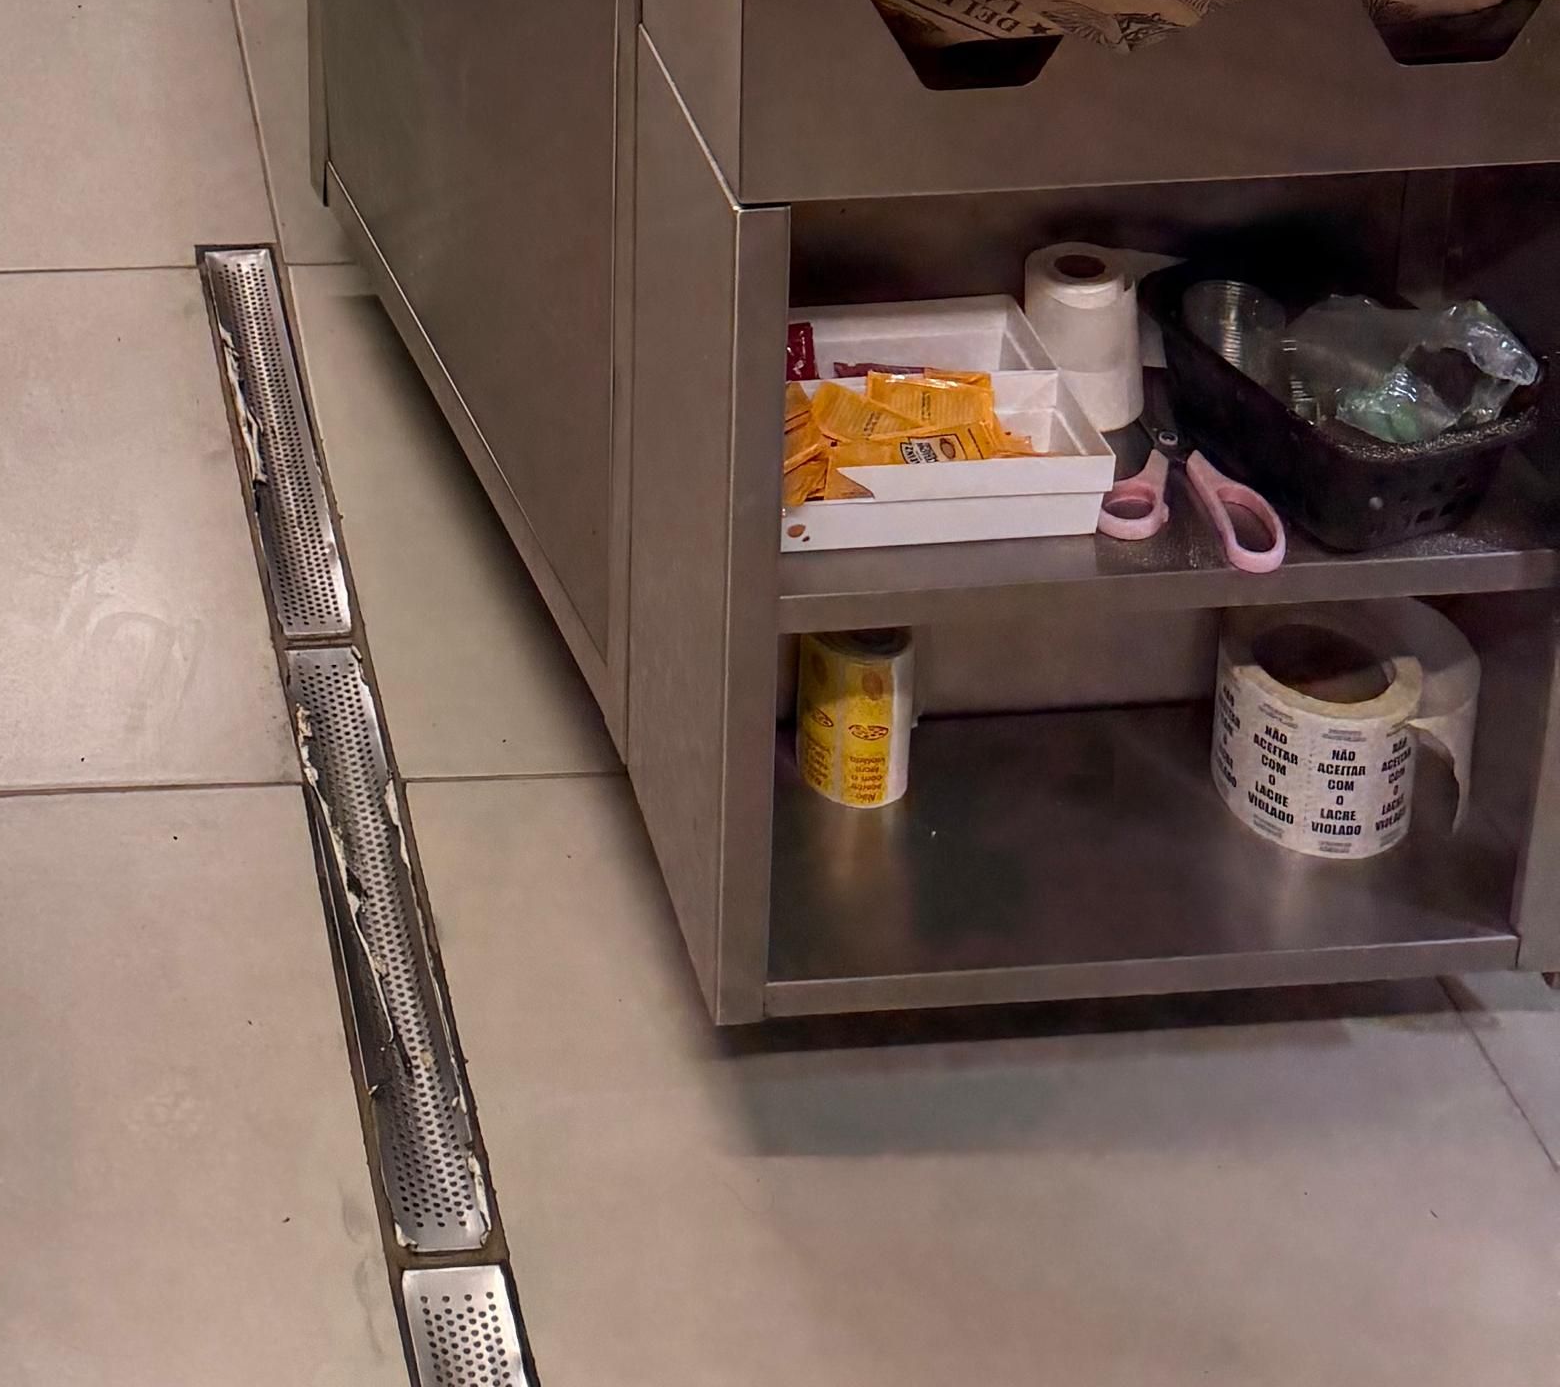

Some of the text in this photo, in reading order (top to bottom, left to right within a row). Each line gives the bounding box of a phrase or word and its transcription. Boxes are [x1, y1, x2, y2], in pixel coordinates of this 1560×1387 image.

[1265, 725, 1288, 745] NÃO
[1253, 733, 1299, 765] ACEITAR
[1332, 749, 1356, 762] NÃO
[1261, 755, 1287, 776] COM
[1317, 763, 1366, 776] ACEITAR
[1327, 780, 1355, 792] COM
[1255, 780, 1289, 808] LACRE
[1336, 795, 1344, 806] O
[1247, 791, 1294, 825] VIOLADO
[1320, 808, 1356, 822] LACRE
[1311, 822, 1362, 836] VIOLADO
